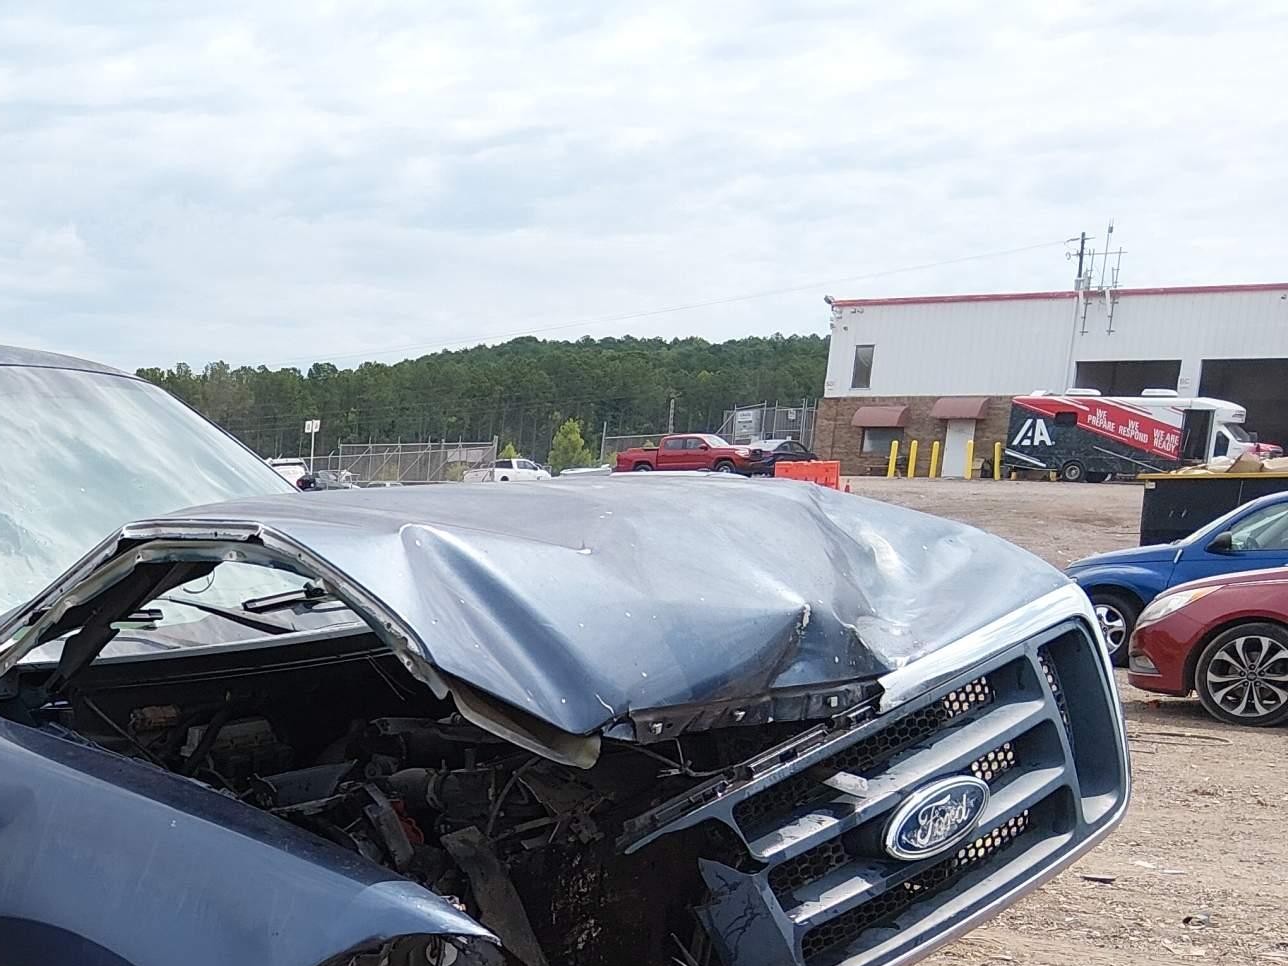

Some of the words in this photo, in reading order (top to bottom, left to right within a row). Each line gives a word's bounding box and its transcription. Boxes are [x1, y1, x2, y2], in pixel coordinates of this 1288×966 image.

[1096, 407, 1108, 420] WE
[1087, 414, 1116, 432] PREPARE
[1128, 419, 1140, 432] WE
[1118, 424, 1149, 444] RESPOND
[1153, 428, 1165, 441] WE
[1164, 432, 1180, 447] ARE
[1153, 438, 1177, 454] READY
[902, 792, 976, 848] Ford
